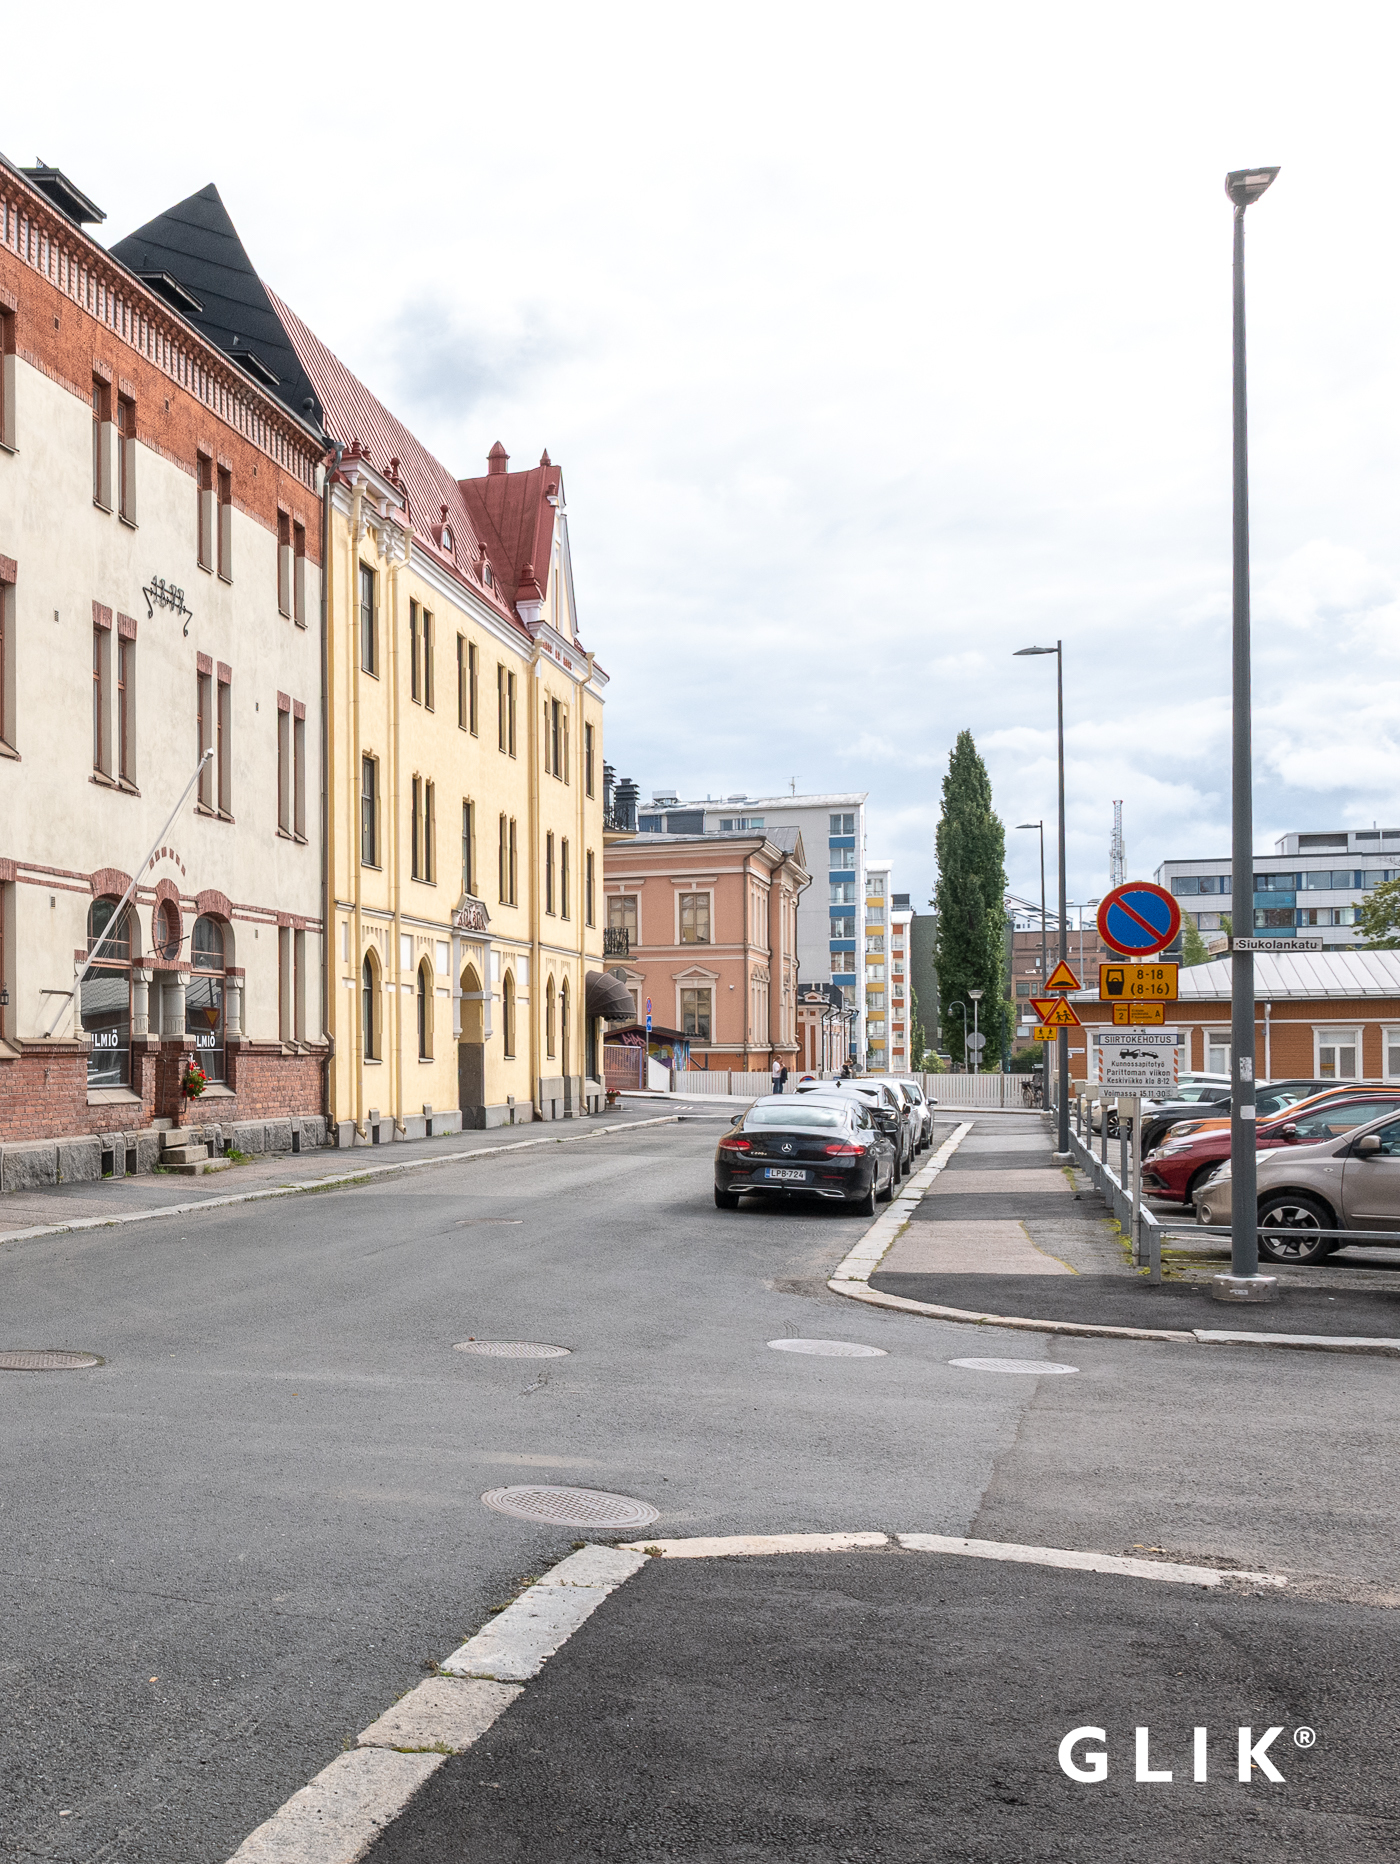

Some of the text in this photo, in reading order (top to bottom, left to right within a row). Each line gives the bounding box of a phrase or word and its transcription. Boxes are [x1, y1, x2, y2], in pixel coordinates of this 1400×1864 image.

[1238, 939, 1317, 950] Siukolankatu
[1137, 969, 1163, 980] 8-18
[1130, 983, 1170, 995] (8-16)
[196, 1031, 216, 1047] LMIÖ
[1104, 1035, 1172, 1044] SIIRTOKEHOTUS
[1111, 1061, 1165, 1069] Kunnossapitotyö
[771, 1169, 804, 1179] LPB-724
